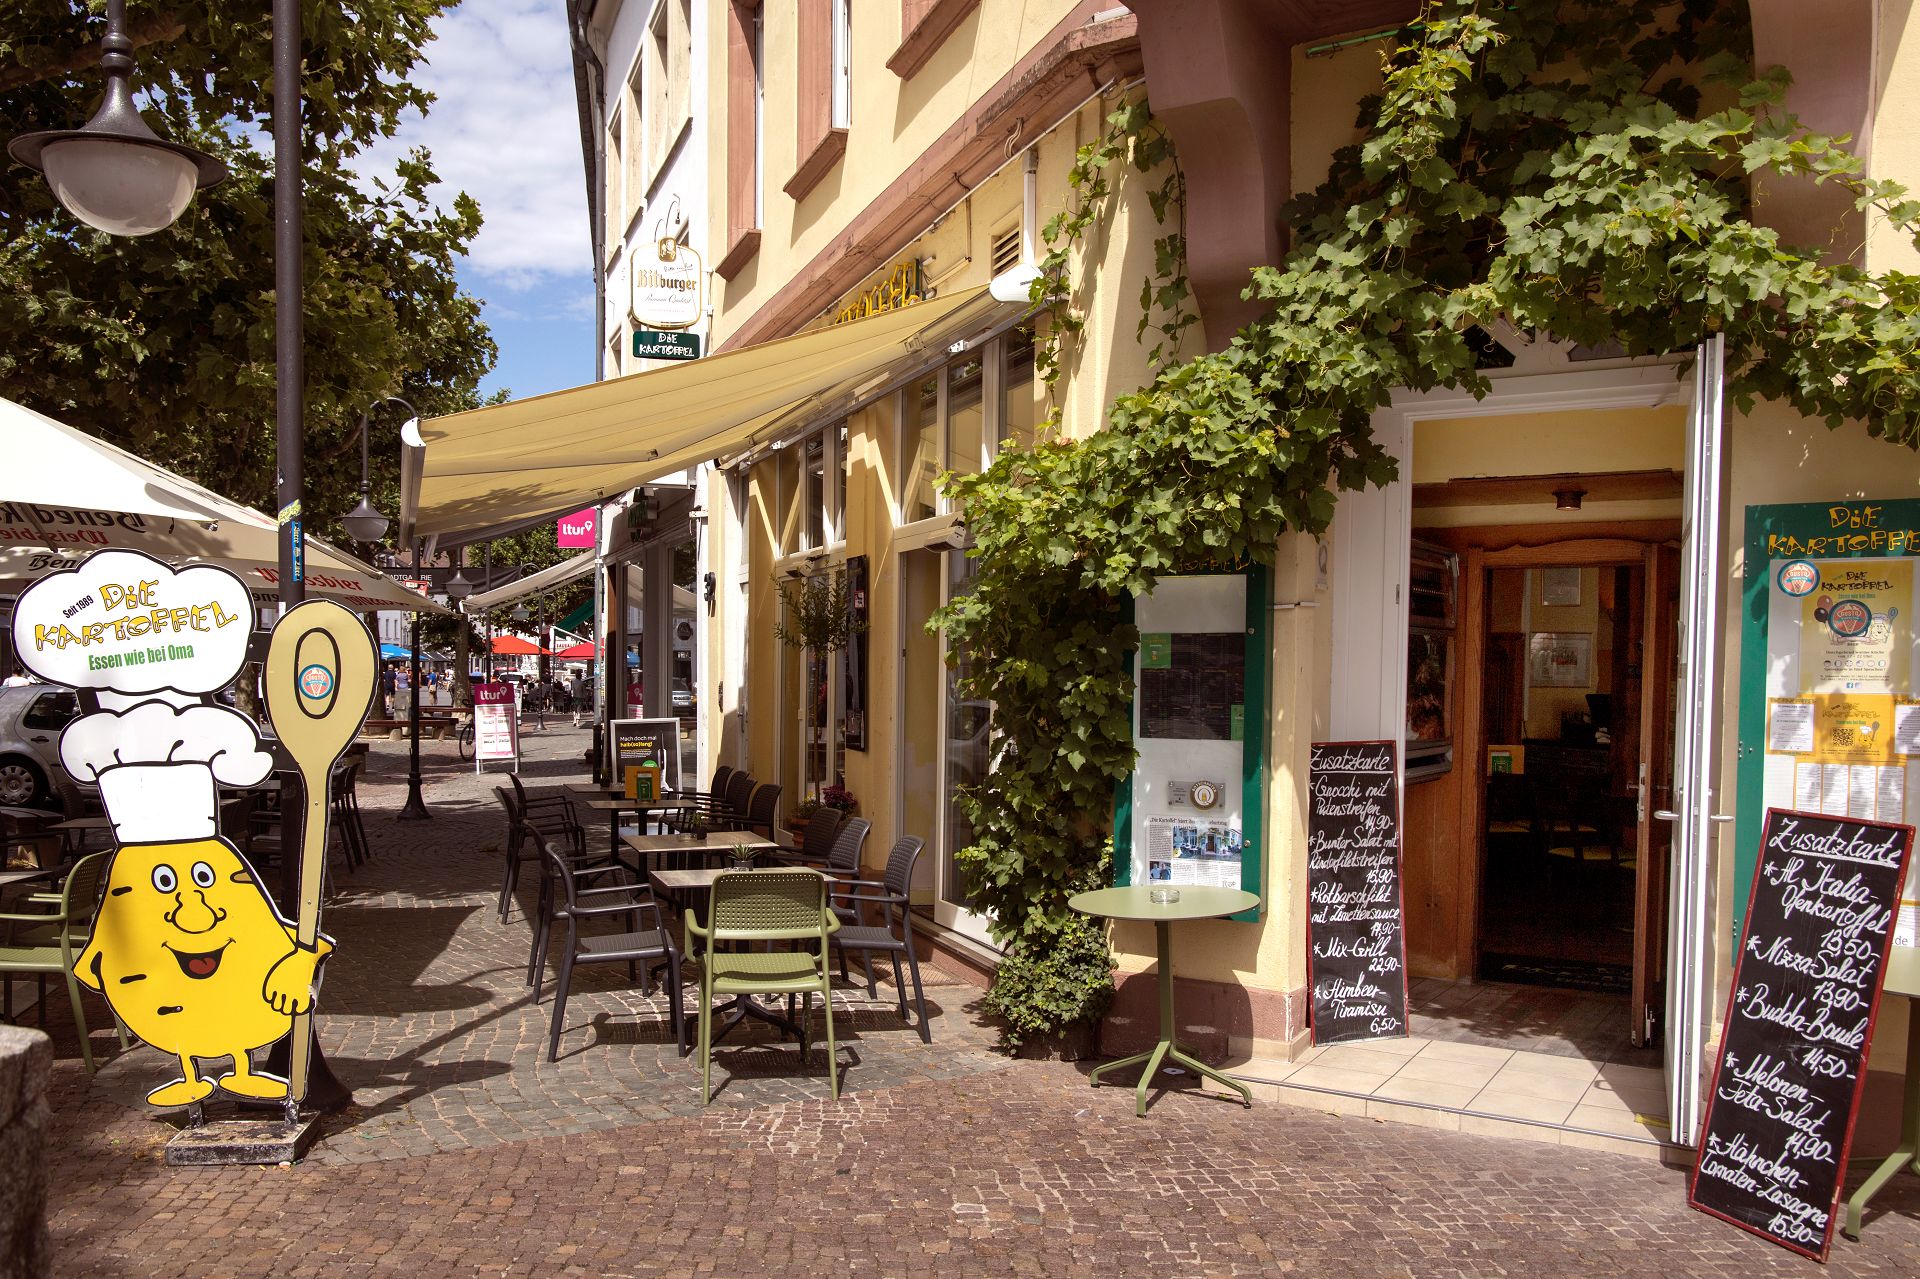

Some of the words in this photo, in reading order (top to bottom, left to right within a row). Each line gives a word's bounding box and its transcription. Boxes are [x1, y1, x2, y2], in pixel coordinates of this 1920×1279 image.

[637, 269, 697, 292] Bitburger
[639, 344, 695, 357] KARTOFFEL
[62, 604, 78, 620] Seit
[76, 595, 95, 611] 1989
[34, 600, 239, 652] KARTOFFEL
[88, 653, 123, 672] Essen
[124, 648, 146, 667] wie
[147, 645, 167, 664] bei
[168, 644, 195, 661] Oma
[1310, 746, 1390, 772] Zusatzkarte
[1315, 775, 1361, 798] Gnocchi
[1365, 777, 1392, 797] mit
[1314, 828, 1352, 852] Bunter
[1383, 831, 1398, 848] mit
[1768, 817, 1903, 864] Zusatzkarte
[1311, 905, 1329, 924] mit
[1781, 884, 1893, 938] Ofenkartoffel
